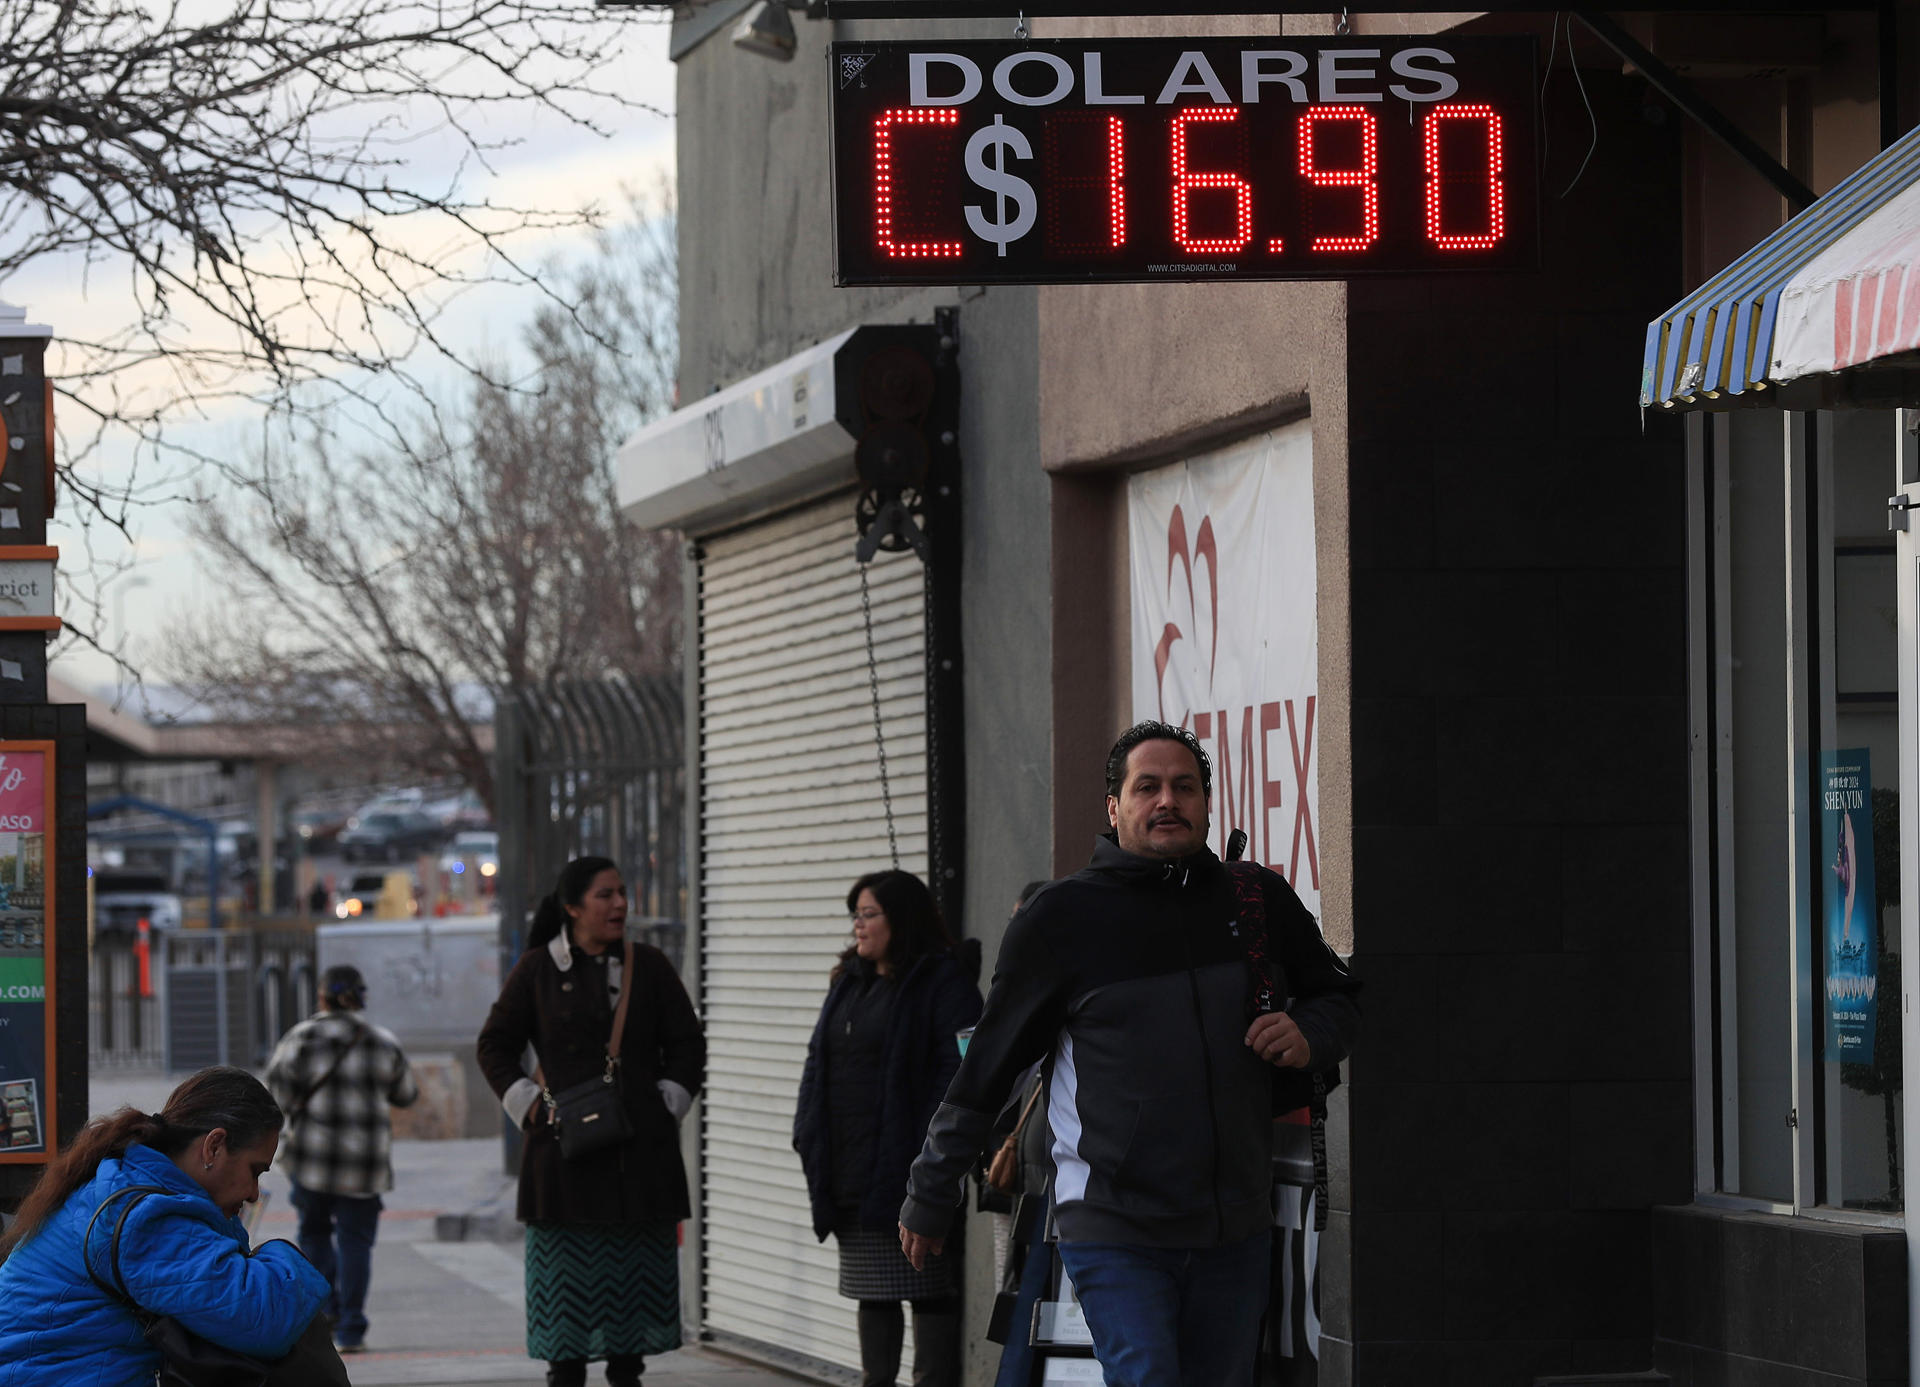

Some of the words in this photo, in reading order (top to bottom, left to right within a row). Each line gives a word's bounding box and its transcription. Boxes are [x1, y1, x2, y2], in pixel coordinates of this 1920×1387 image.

[909, 47, 1459, 106] DOLARES
[1147, 263, 1237, 273] WWW.CITSADIGITAL.COM
[1824, 791, 1845, 810] SHEN
[1846, 790, 1863, 809] YUN
[0, 985, 45, 999] .COM
